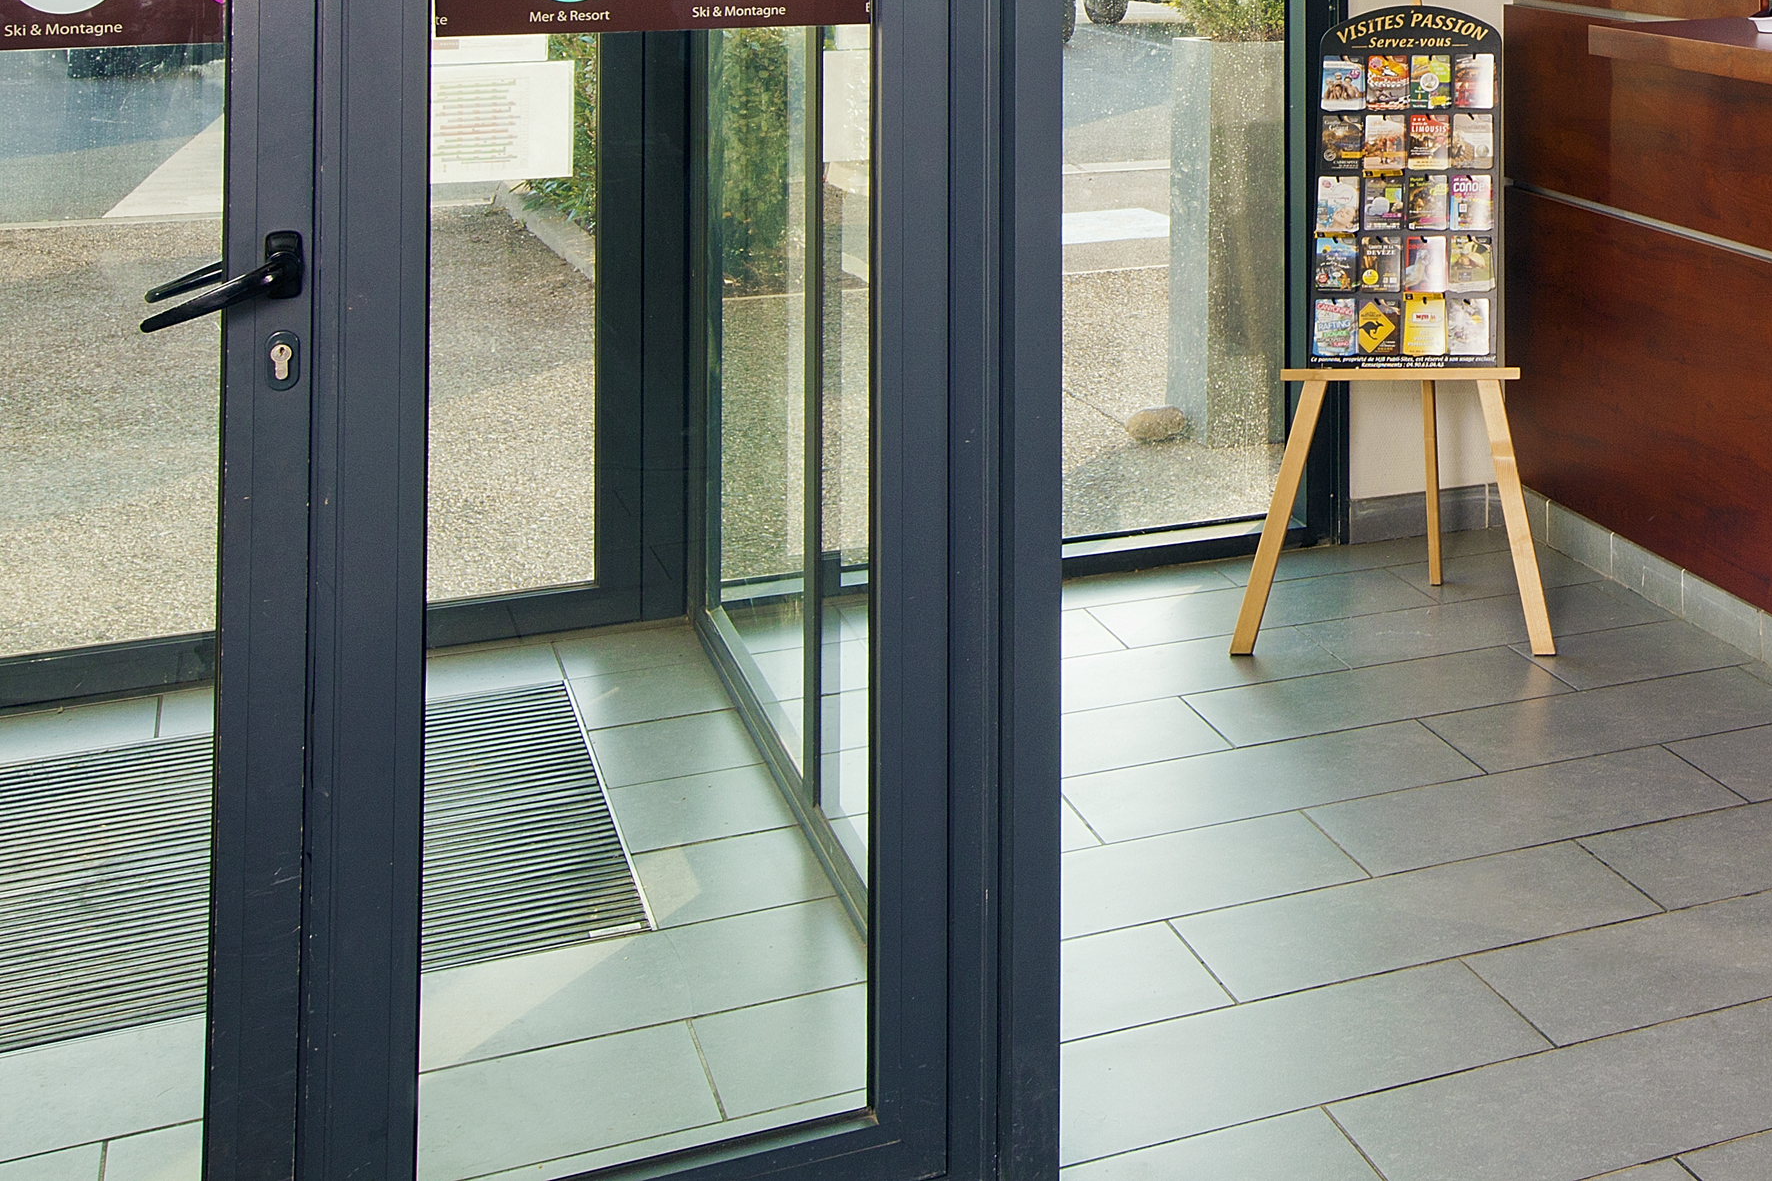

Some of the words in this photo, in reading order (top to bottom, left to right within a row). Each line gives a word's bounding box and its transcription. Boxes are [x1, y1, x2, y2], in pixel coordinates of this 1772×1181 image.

[529, 11, 554, 23] Mer
[557, 11, 567, 22] &
[570, 10, 610, 21] Resort
[692, 6, 710, 18] Ski
[712, 6, 723, 17] &
[724, 4, 786, 20] Montagne
[4, 24, 26, 37] Ski
[30, 23, 42, 36] &
[45, 23, 123, 37] Montagne
[1336, 13, 1404, 44] VISITES
[1410, 12, 1489, 41] PASSION
[1368, 36, 1452, 48] Servez-vous
[1411, 125, 1447, 133] LIMOUSIS
[1316, 303, 1353, 316] CANYONING
[1317, 320, 1350, 331] RAFTING
